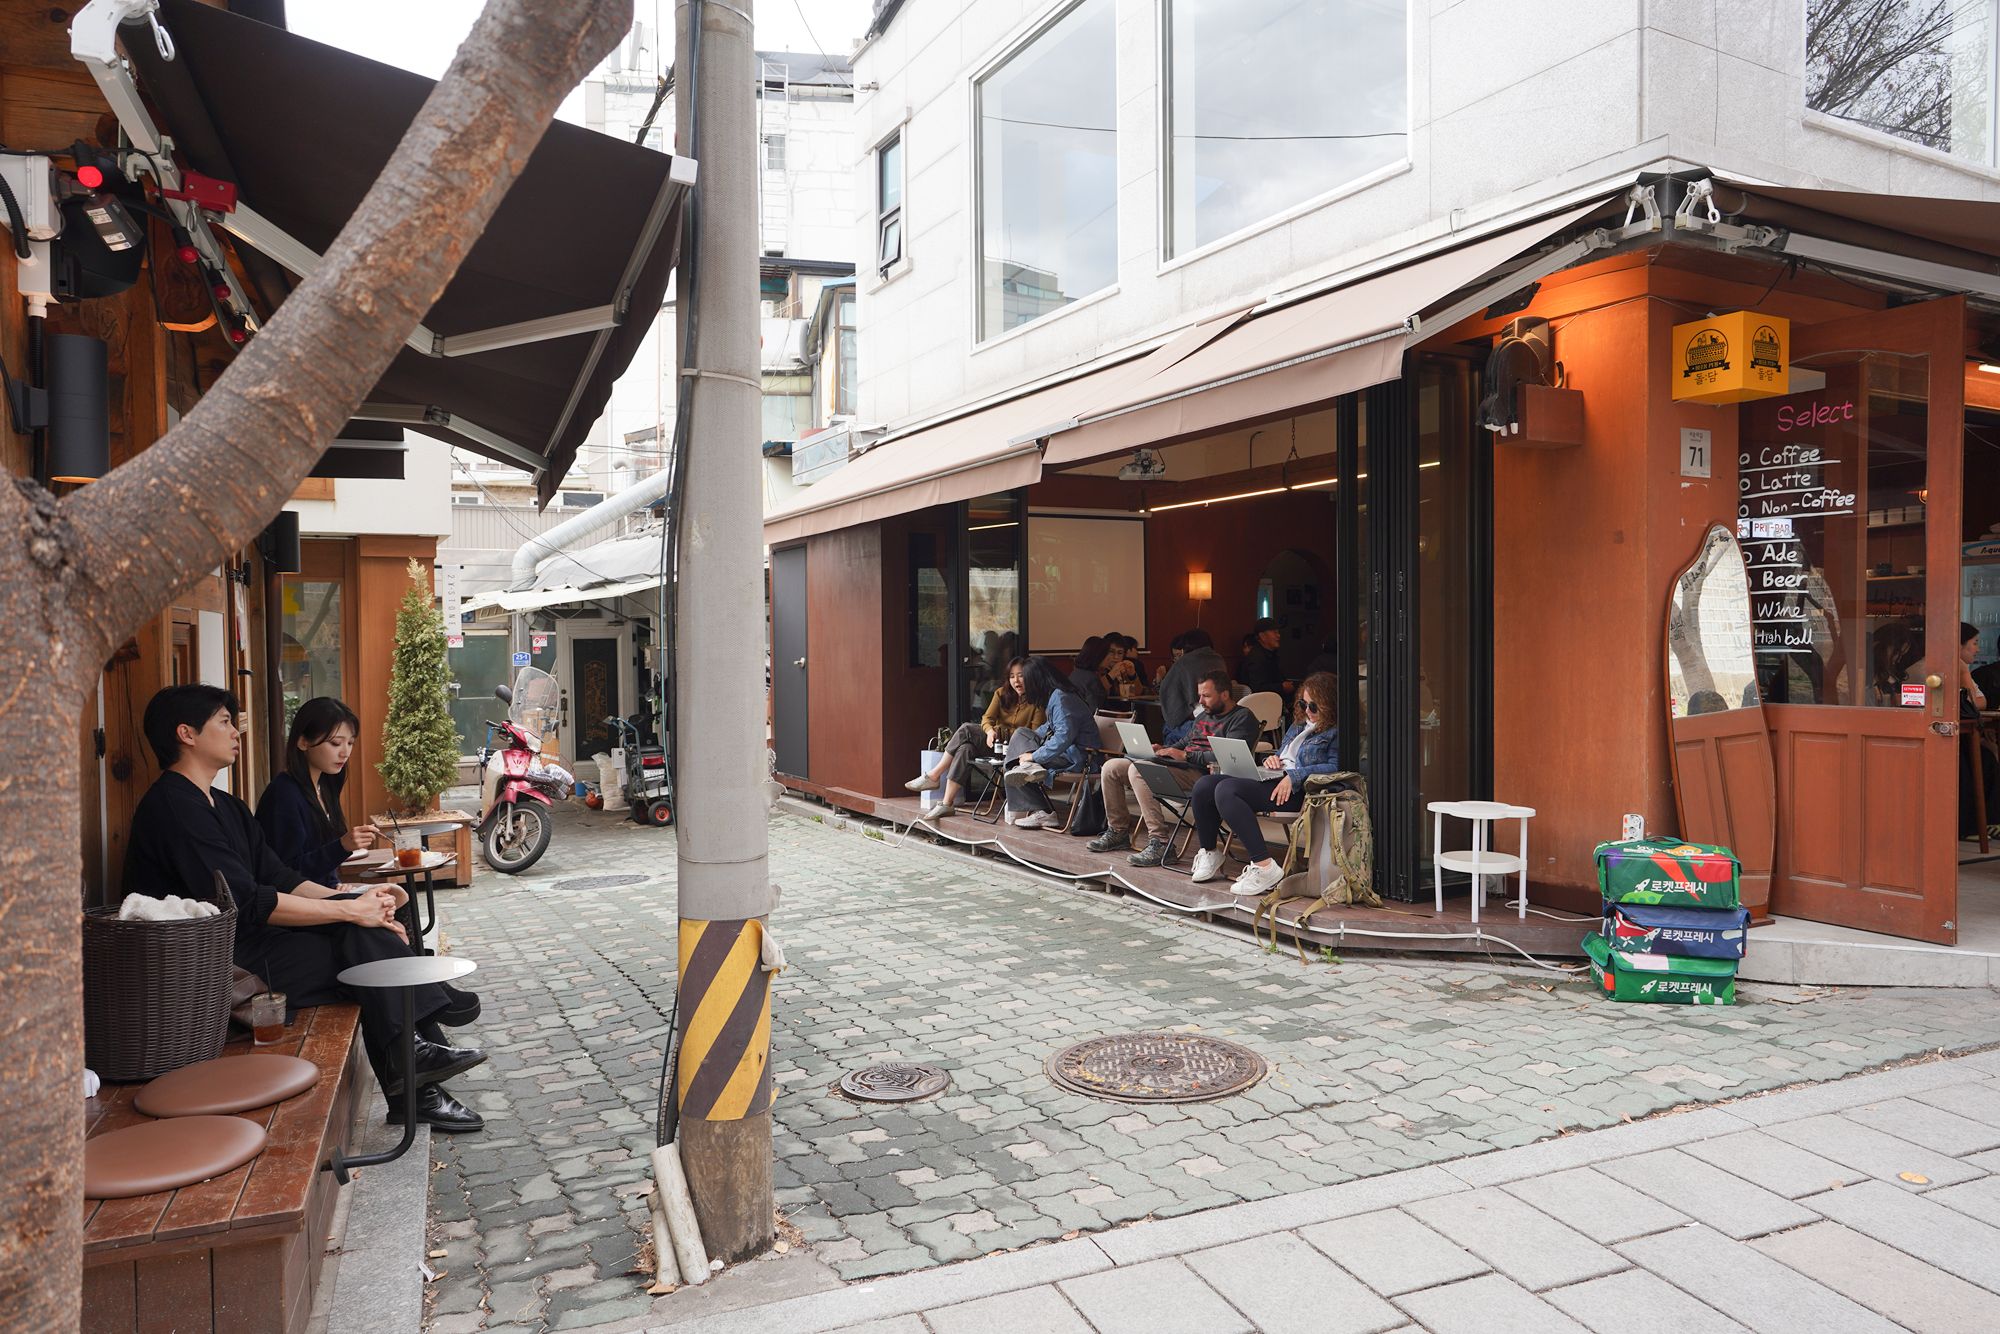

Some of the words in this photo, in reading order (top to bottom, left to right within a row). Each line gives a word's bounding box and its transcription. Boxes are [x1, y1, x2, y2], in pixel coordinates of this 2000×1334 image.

[1777, 400, 1853, 431] Select
[1689, 446, 1703, 467] 71
[1760, 445, 1821, 465] Coffee
[1760, 471, 1812, 490] Latte
[1761, 543, 1798, 562] Ade
[1762, 570, 1808, 588] Beer
[1757, 601, 1807, 618] Wine
[1650, 880, 1707, 894] 로켓프레시
[1661, 929, 1714, 943] 로켓프레시
[1657, 981, 1712, 994] 로켓프레시
